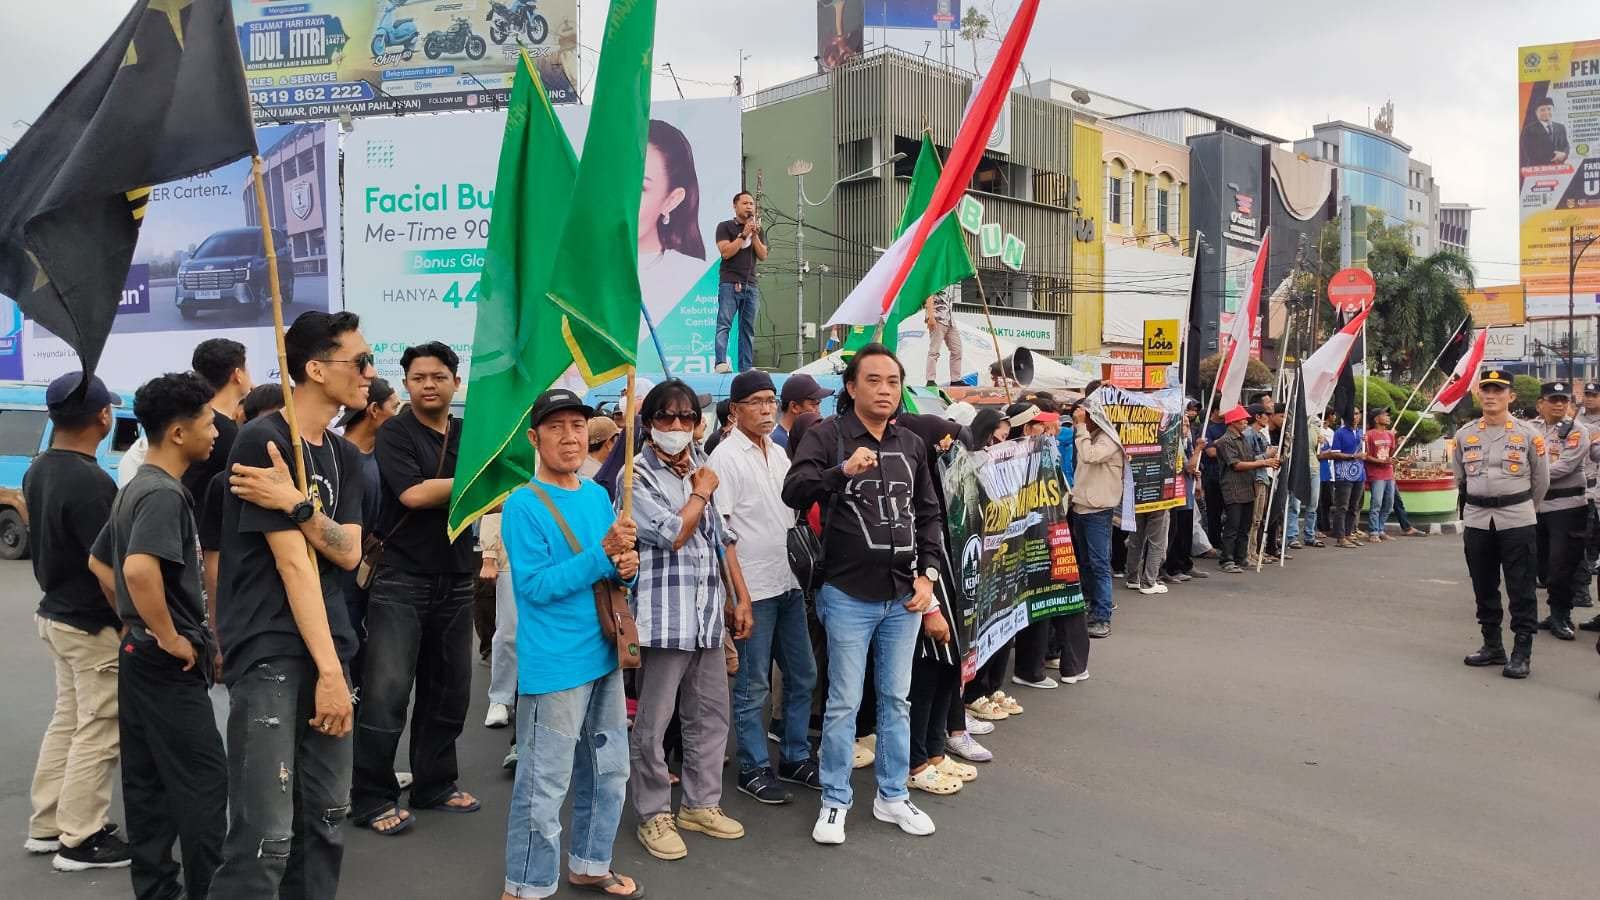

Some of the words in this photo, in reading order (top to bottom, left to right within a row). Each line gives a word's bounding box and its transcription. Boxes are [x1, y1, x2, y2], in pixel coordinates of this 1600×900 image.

[249, 21, 283, 32] SELAMAT
[285, 18, 304, 29] HARI
[304, 17, 326, 27] RAYA
[249, 30, 285, 62] IDUL
[289, 26, 326, 59] FITRI
[1570, 59, 1600, 78] PEN
[279, 76, 287, 86] &
[288, 72, 337, 84] SERVICE
[248, 90, 289, 105] 0819
[294, 88, 326, 101] 862
[330, 85, 363, 99] 222
[454, 96, 463, 104] US
[279, 106, 308, 118] UMAR,
[309, 104, 331, 117] (DPN
[332, 101, 366, 114] MAKAM
[148, 187, 171, 202] ER
[173, 184, 233, 200] Cartenz.
[365, 183, 448, 214] Facial
[364, 220, 458, 243] Me-Time
[463, 218, 491, 240] 90
[413, 253, 457, 269] Bonus
[460, 252, 486, 269] Glo
[382, 287, 438, 304] HANYA
[369, 342, 389, 354] AP
[1148, 336, 1174, 350] Lois
